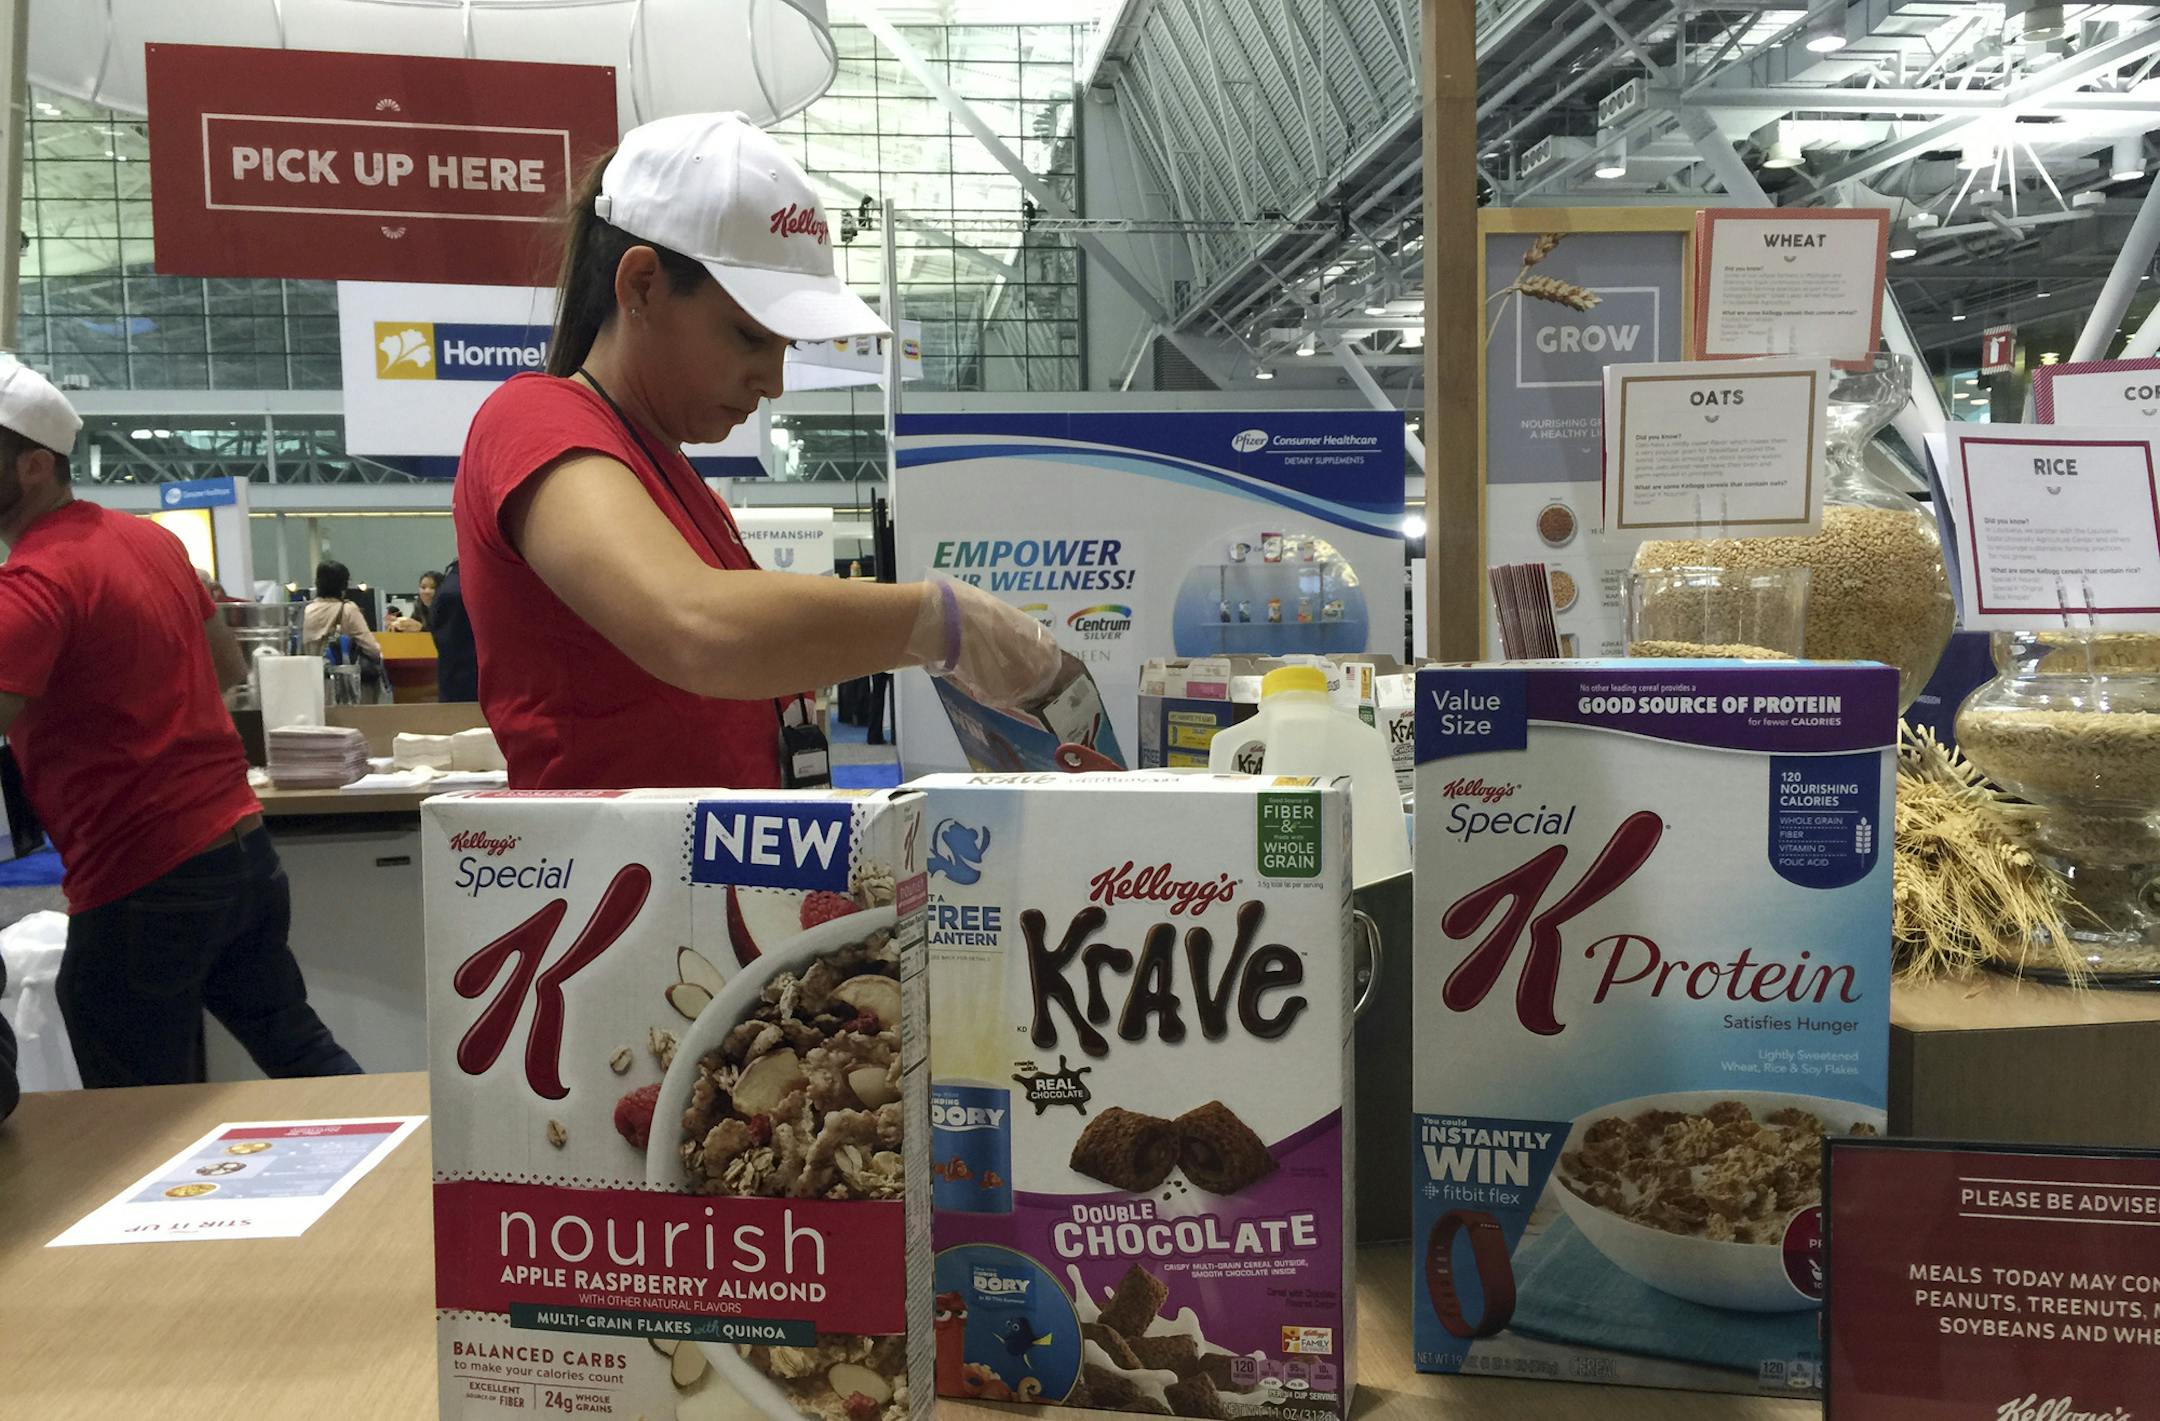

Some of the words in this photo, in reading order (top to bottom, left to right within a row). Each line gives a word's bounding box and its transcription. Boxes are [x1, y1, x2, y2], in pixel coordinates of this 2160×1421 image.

[232, 147, 340, 185] PICK
[353, 151, 414, 187] UP
[428, 155, 546, 194] HERE
[1764, 234, 1826, 248] WHEAT
[1536, 324, 1640, 353] GROW
[1690, 389, 1744, 406] OATS
[1521, 418, 1588, 430] NOURISHING
[1234, 432, 1267, 452] Pfizer
[1273, 435, 1322, 446] Consumer
[1323, 435, 1378, 445] Healthcare
[1530, 430, 1538, 439] A
[1541, 428, 1588, 439] HEALTHY
[1284, 457, 1314, 465] DIETARY
[1315, 456, 1365, 464] SUPPLEMENTS
[2034, 458, 2078, 476] RICE
[932, 540, 1122, 568] EMPOWER
[991, 569, 1136, 592] WELLNESS!
[1075, 618, 1131, 632] Centrum
[1083, 632, 1122, 640] SILVER
[1580, 684, 1590, 692] No
[1591, 684, 1609, 692] other
[1610, 684, 1637, 694] leading
[1638, 684, 1659, 692] cereal
[1660, 684, 1691, 694] provides
[1432, 689, 1501, 711] Value
[1578, 696, 1636, 714] GOOD
[1638, 696, 1718, 714] SOURCE
[1721, 696, 1749, 714] OF
[1753, 696, 1842, 714] PROTEIN
[1441, 714, 1492, 735] Size
[1748, 717, 1761, 726] for
[1762, 717, 1789, 726] fewer
[1791, 717, 1842, 726] CALORIES
[1781, 772, 1801, 782] 120
[1442, 777, 1516, 804] Kellogg's
[1780, 784, 1859, 794] NOURISHING
[1780, 796, 1839, 806] CALORIES
[1264, 805, 1314, 819] FIBER
[1281, 820, 1293, 833] &
[1446, 803, 1576, 843] Special
[1780, 817, 1812, 825] WHOLE
[1814, 817, 1843, 825] GRAIN
[451, 830, 520, 856] Kellogg's
[703, 811, 843, 871] NEW
[1264, 842, 1315, 854] WHOLE
[1264, 855, 1314, 868] GRAIN
[1779, 858, 1804, 866] FOLIC
[455, 856, 574, 897] Special
[1089, 860, 1237, 916] Kellogg's
[1442, 810, 1663, 1036] K
[928, 932, 997, 946] ANTERN
[1584, 933, 1863, 1005] Protein
[453, 862, 652, 1100] K
[1723, 1015, 1792, 1030] Satisfies
[1797, 1017, 1859, 1035] Hunger
[1758, 1050, 1795, 1062] Lightly
[1797, 1050, 1859, 1061] Sweetened
[1721, 1061, 1761, 1073] Wheat,
[1764, 1062, 1787, 1073] Rice
[1789, 1063, 1798, 1074] &
[1801, 1063, 1822, 1077] Soy
[1825, 1064, 1859, 1075] Flakes
[1035, 1078, 1076, 1091] REAL
[1031, 1090, 1084, 1099] CHOCOLATE
[931, 1105, 1005, 1126] DORY
[1422, 1117, 1440, 1125] You
[1421, 1125, 1551, 1150] INSTANTLY
[1422, 1144, 1529, 1187] WIN
[1443, 1184, 1485, 1202] fitbit
[1489, 1187, 1520, 1205] flex
[1961, 1189, 2041, 1209] PLEASE
[2047, 1193, 2073, 1210] BE
[2078, 1194, 2160, 1215] ADVISE
[1072, 1203, 1155, 1224] DOUBLE
[124, 1224, 160, 1234] UP
[168, 1222, 190, 1230] IT
[199, 1218, 252, 1229] STIR
[500, 1206, 826, 1276] nourish
[1053, 1214, 1318, 1259] CHOCOLATE
[1192, 1262, 1241, 1270] MULTI-GRAIN
[1243, 1261, 1272, 1269] CEREAL
[1274, 1259, 1309, 1267] OUTSIDE,
[1191, 1270, 1223, 1278] SMOOTH
[1225, 1269, 1269, 1277] CHOCOLATE
[1909, 1264, 1982, 1284] MEALS
[1993, 1268, 2065, 1288] TODAY
[2069, 1273, 2116, 1291] MAY
[500, 1264, 567, 1288] APPLE
[575, 1270, 708, 1297] RASPBERRY
[718, 1279, 827, 1303] ALMOND
[974, 1276, 1030, 1293] DORY
[579, 1293, 605, 1304] WITH
[607, 1295, 642, 1308] OTHER
[643, 1297, 692, 1311] NATURAL
[694, 1302, 742, 1314] FLAVORS
[1916, 1290, 2022, 1313] PEANUTS,
[2028, 1296, 2148, 1320] TREENUTS,
[536, 1312, 633, 1330] MULTI-GRAIN
[637, 1318, 692, 1335] FLAKES
[722, 1324, 787, 1340] QUINOA
[1939, 1317, 2055, 1340] SOYBEANS
[2061, 1323, 2107, 1342] AND
[1301, 1338, 1329, 1347] FAMILY
[453, 1341, 554, 1364] BALANCED
[563, 1351, 627, 1370] CARBS
[1417, 1352, 1433, 1364] NET
[454, 1359, 467, 1370] to
[471, 1360, 502, 1374] make
[506, 1366, 533, 1379] your
[536, 1368, 584, 1382] calories
[588, 1372, 624, 1384] count
[1235, 1360, 1254, 1373] 120
[1763, 1361, 1784, 1374] 120
[469, 1381, 521, 1395] EXCELLENT
[499, 1396, 525, 1408] FIBER
[545, 1390, 573, 1413] 24g
[576, 1393, 611, 1404] WHOLE
[576, 1403, 613, 1413] GRAINS
